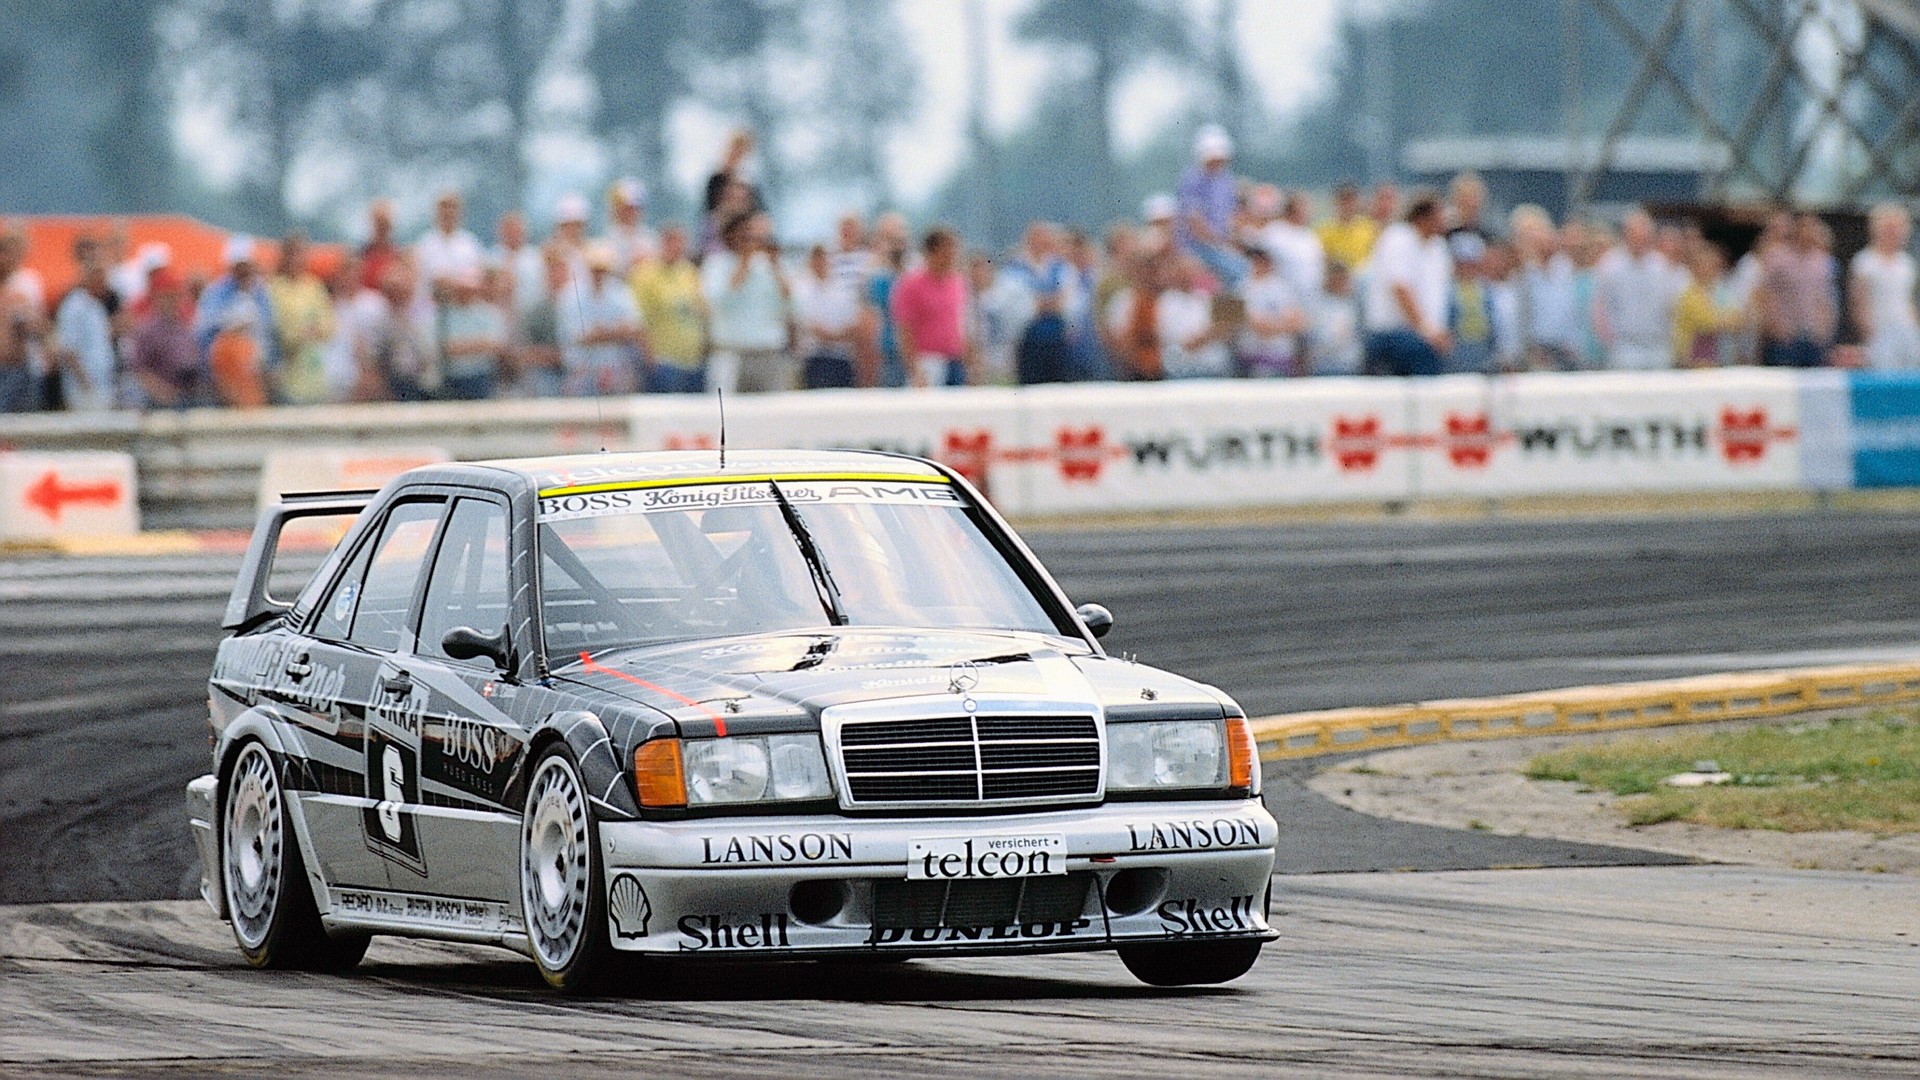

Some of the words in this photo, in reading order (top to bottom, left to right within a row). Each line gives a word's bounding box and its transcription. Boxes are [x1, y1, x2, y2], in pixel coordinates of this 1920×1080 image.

[539, 491, 631, 515] BOSS
[828, 486, 957, 501] AMG
[443, 710, 496, 774] BOSS
[379, 744, 404, 844] 6
[701, 833, 852, 864] LANSON
[988, 837, 1049, 849] versichert
[1125, 818, 1260, 851] LANSON
[922, 839, 1052, 878] telcon
[1157, 895, 1260, 934] Shell
[677, 913, 791, 950] Shell
[863, 918, 1091, 945] DUNLOP
